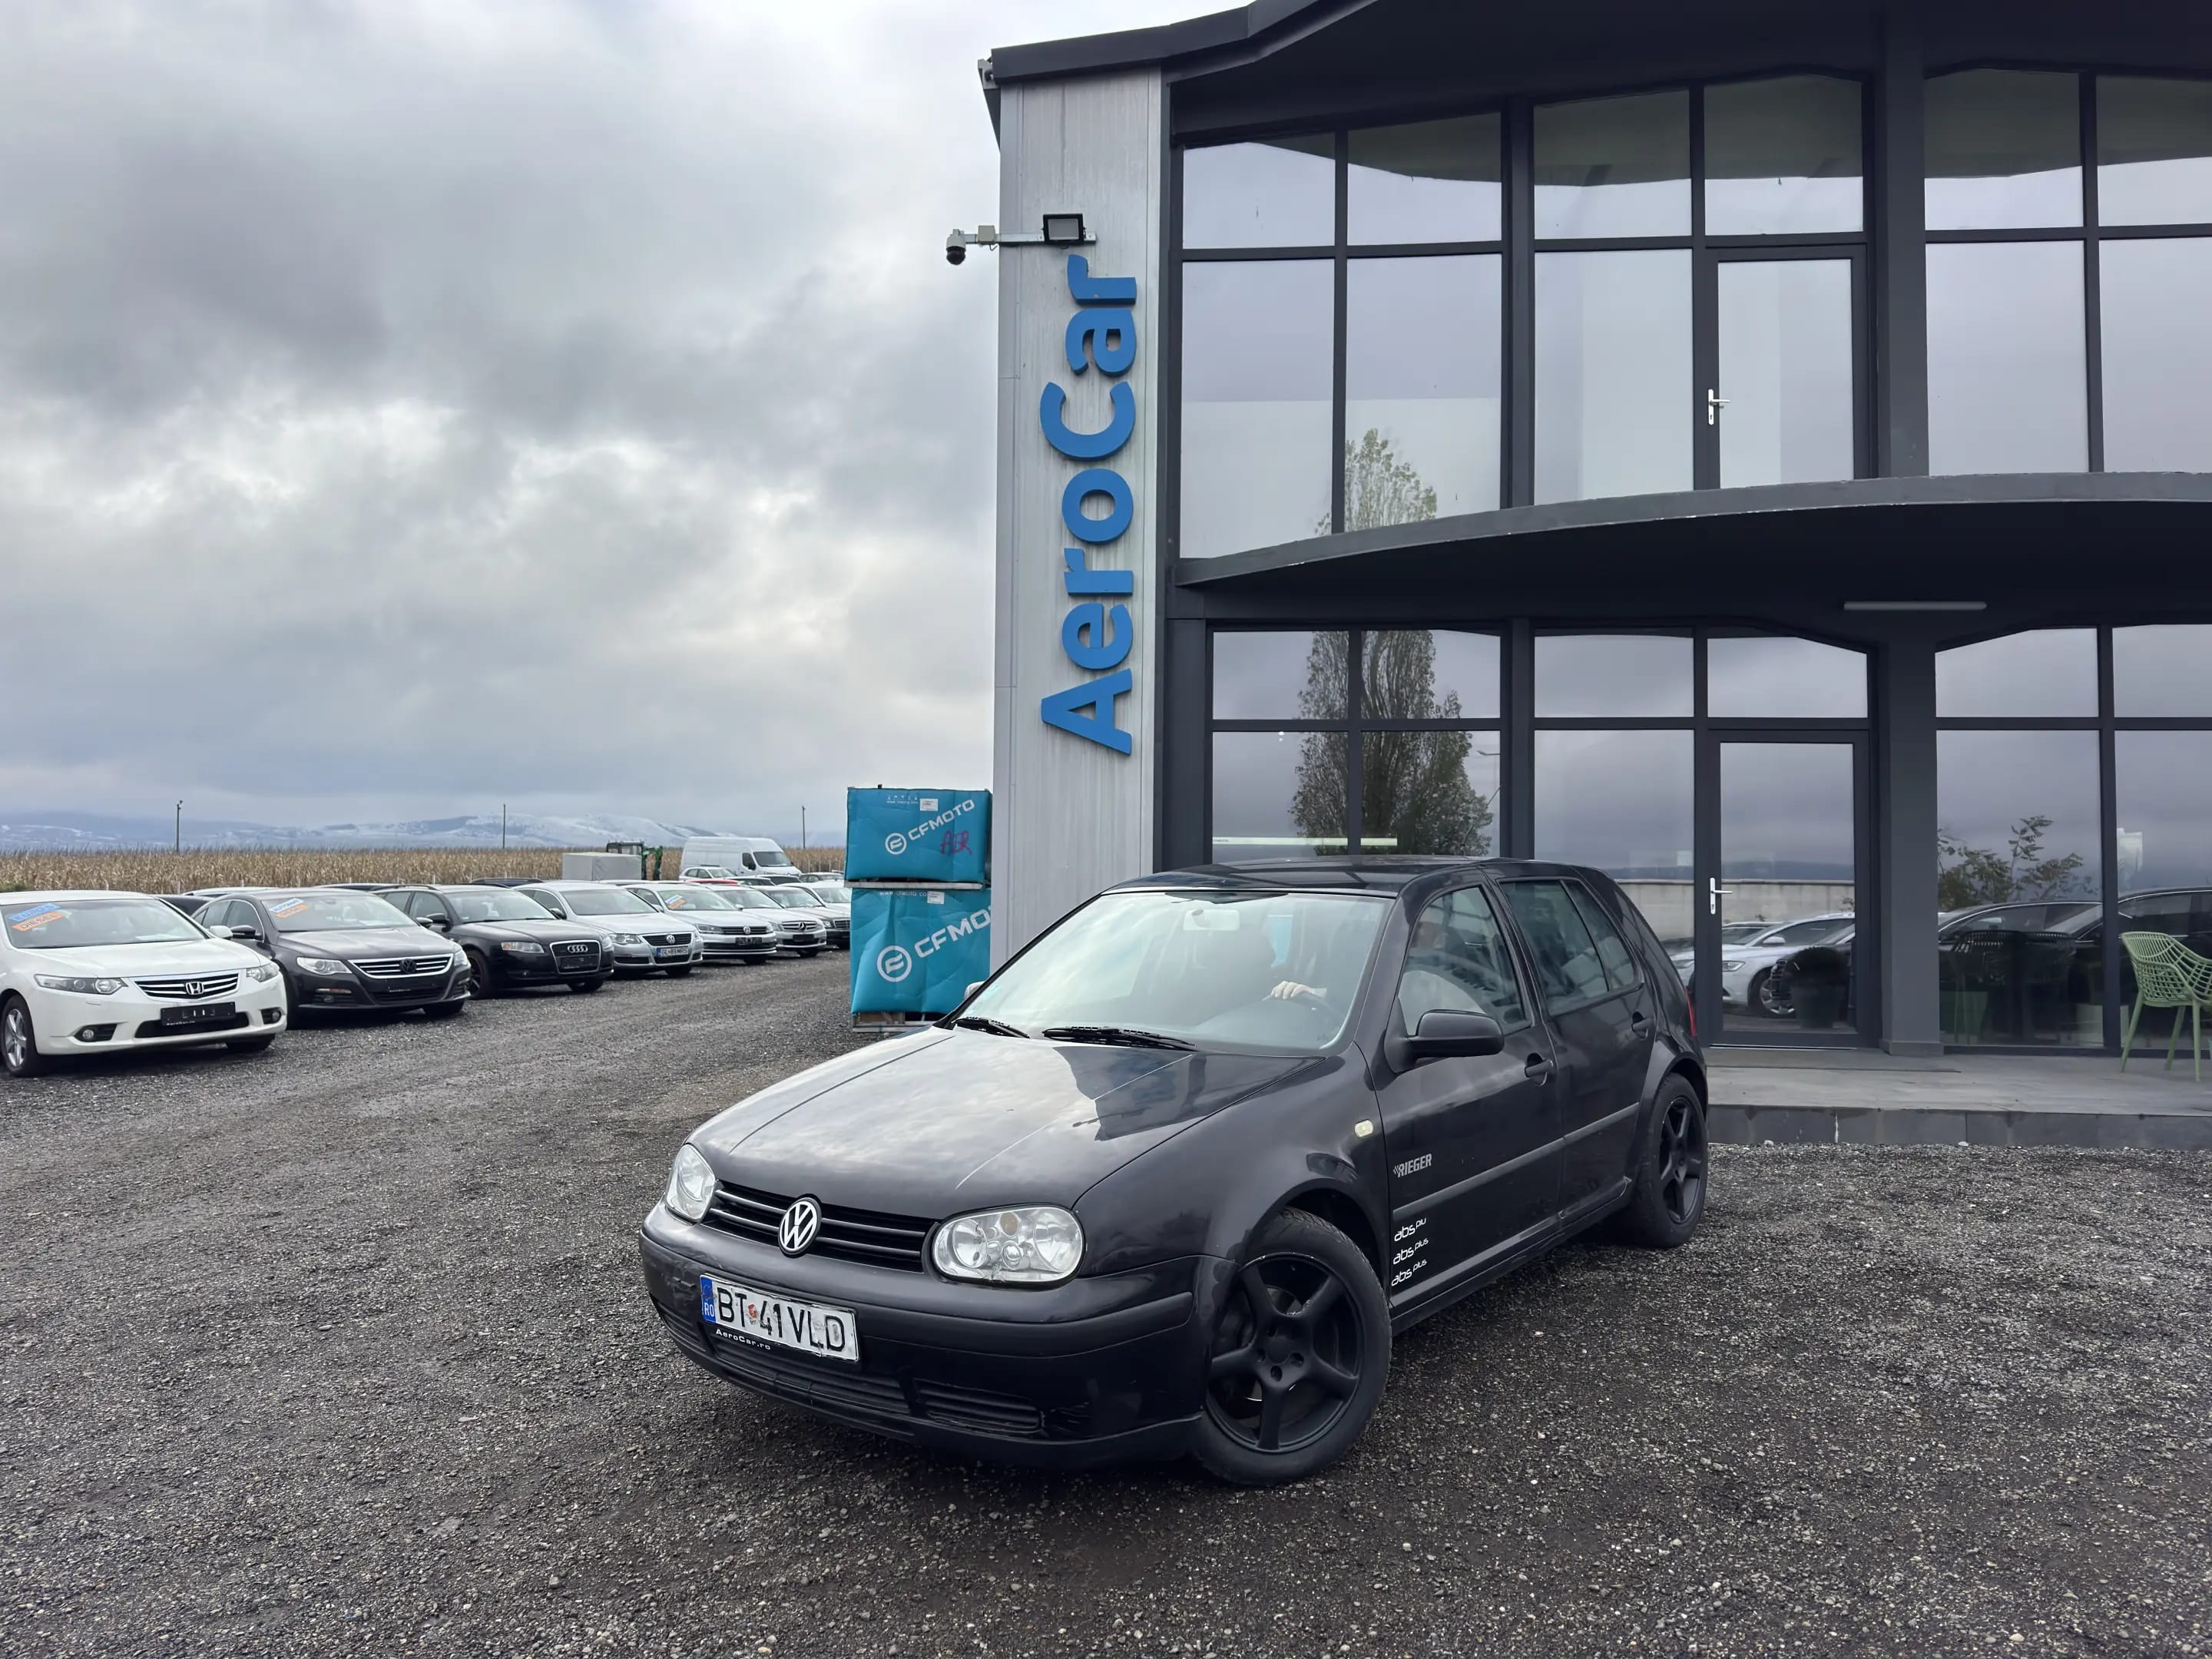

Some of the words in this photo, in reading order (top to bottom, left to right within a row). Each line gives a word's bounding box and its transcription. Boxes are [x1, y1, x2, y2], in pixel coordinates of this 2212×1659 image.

[1040, 254, 1137, 755] AeroCar
[908, 799, 975, 840] CFMOTO
[21, 914, 55, 929] DIESEL
[914, 906, 991, 958] CFMO
[1398, 1154, 1432, 1177] RIEGER
[1394, 1225, 1416, 1242] abs
[1392, 1247, 1414, 1265] abs
[1414, 1238, 1429, 1251] plus
[1391, 1268, 1412, 1286] abs
[1413, 1259, 1428, 1272] plus
[704, 1302, 715, 1317] RO
[716, 1328, 771, 1350] AeroCar.ro
